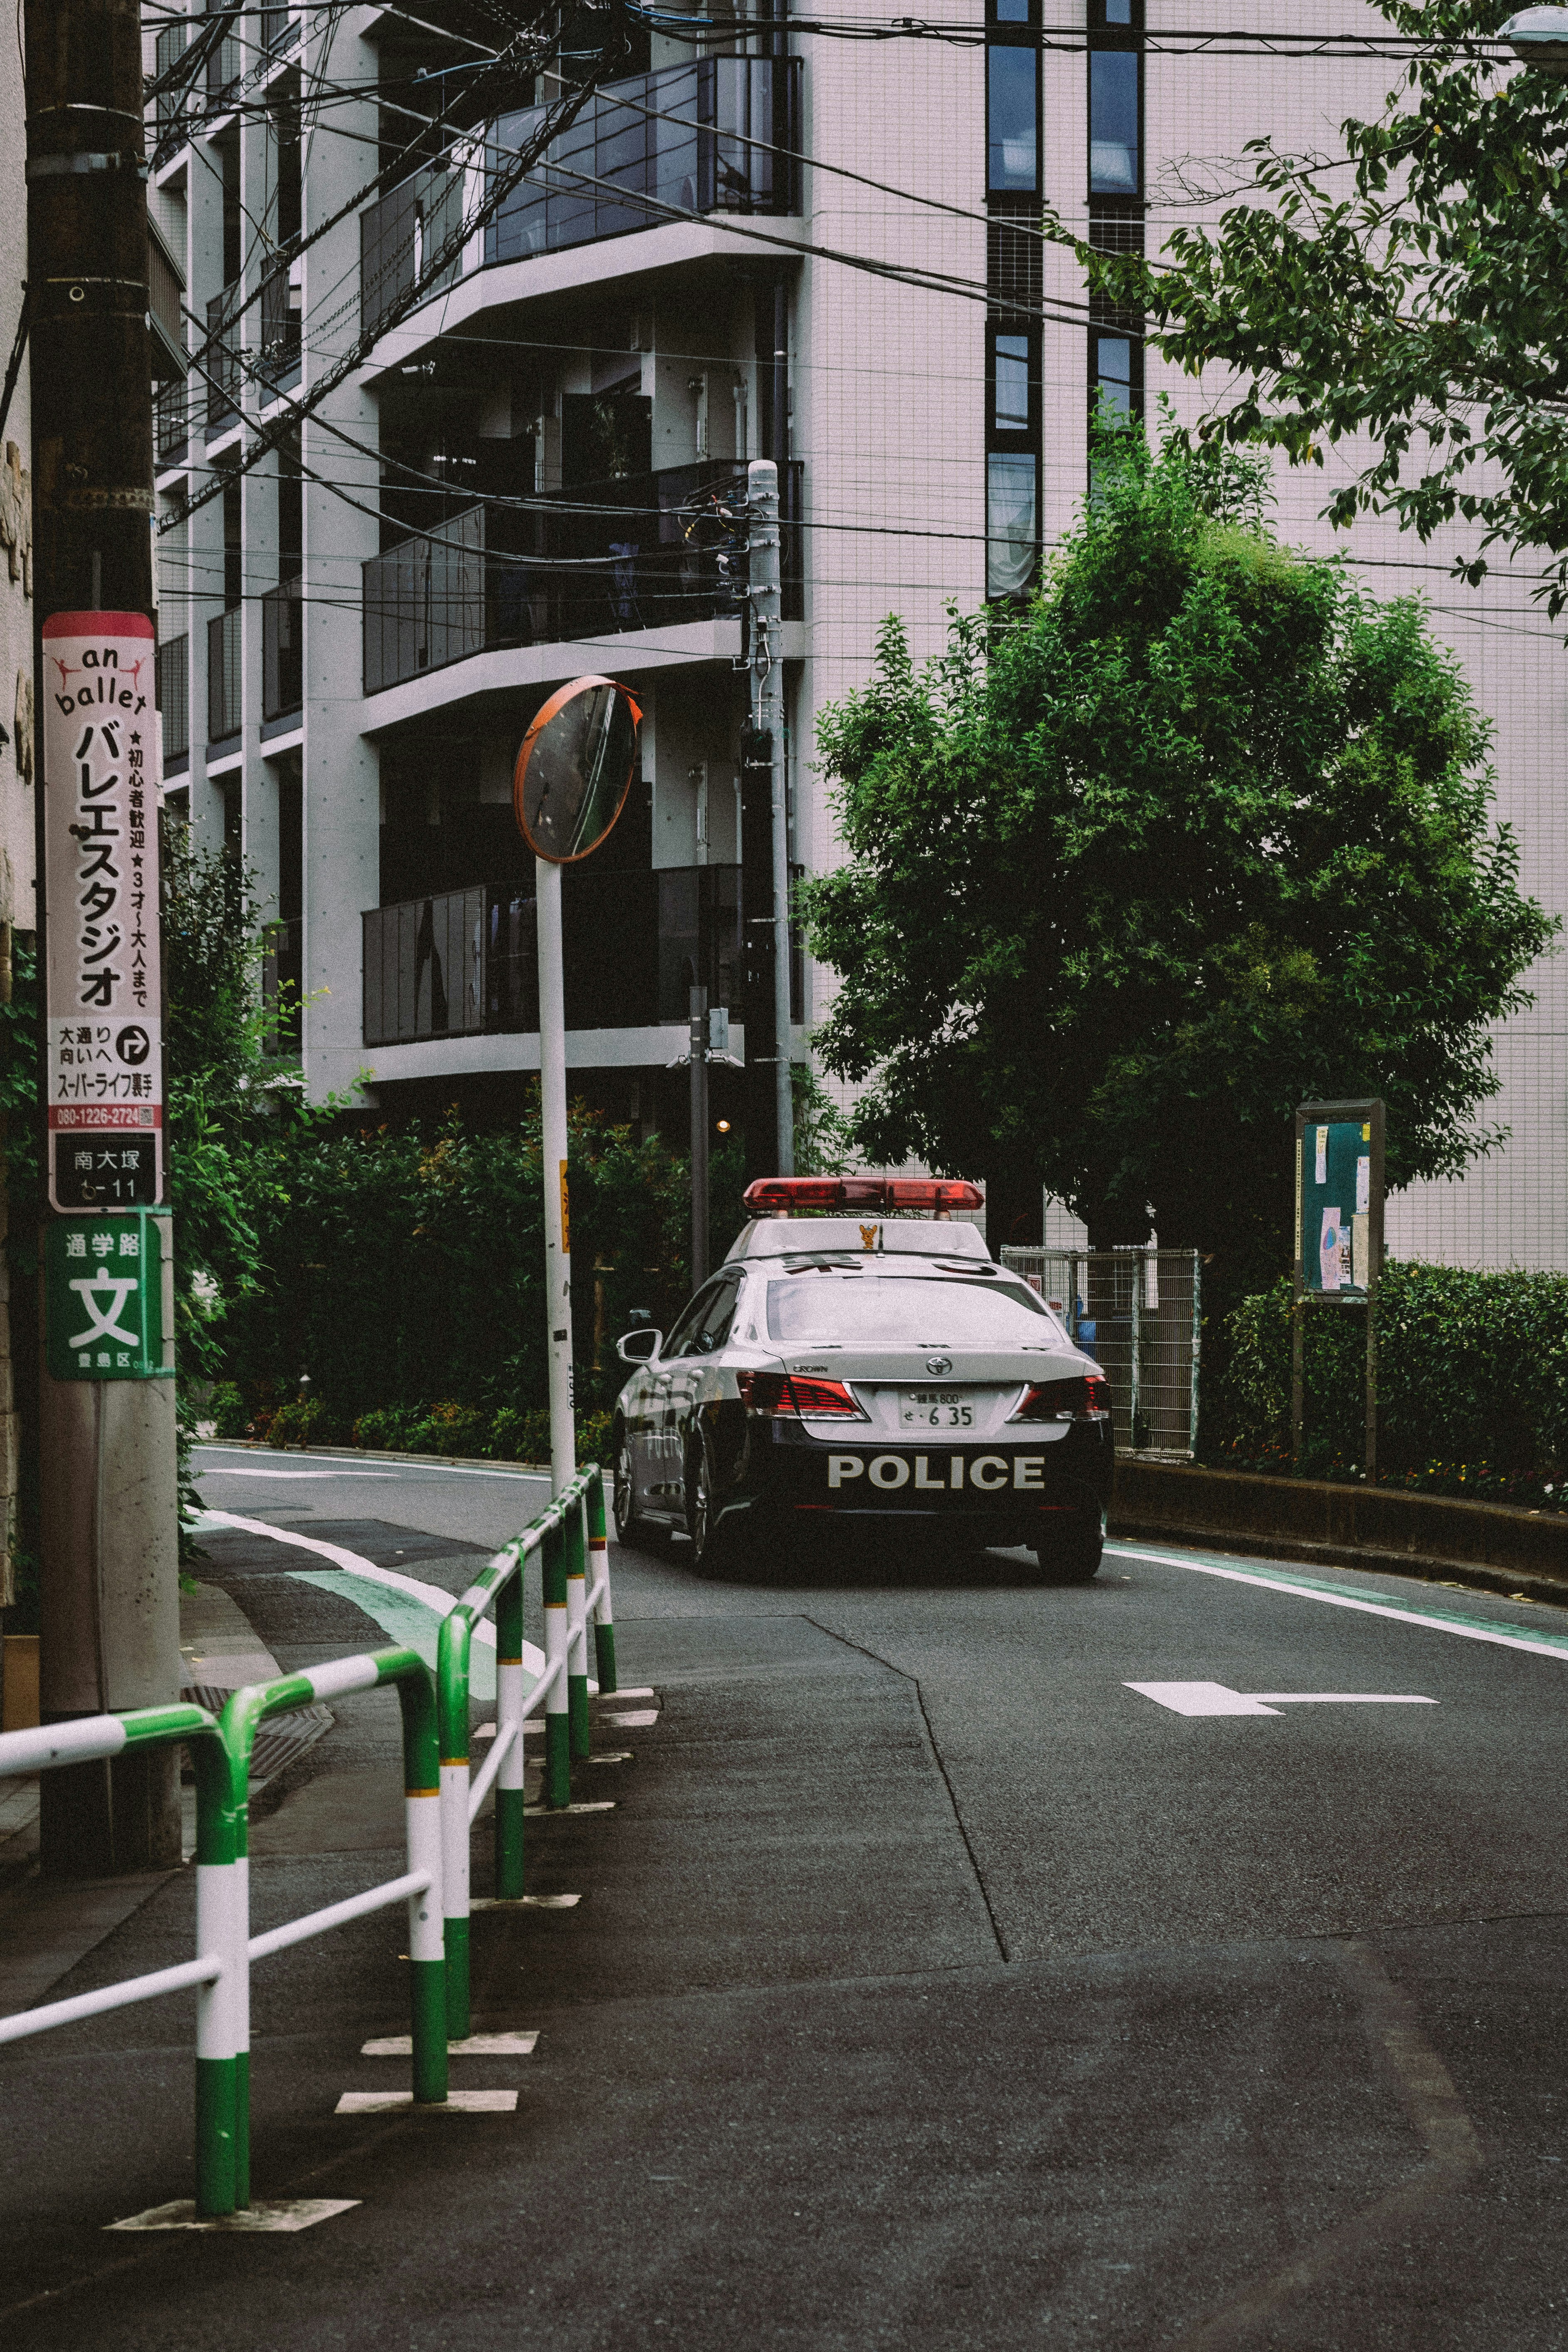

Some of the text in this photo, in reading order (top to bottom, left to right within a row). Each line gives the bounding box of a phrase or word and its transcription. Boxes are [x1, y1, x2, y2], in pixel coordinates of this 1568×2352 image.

[82, 648, 118, 668] an
[55, 676, 146, 716] ballet
[76, 720, 120, 1007] バレエスタジオ
[59, 1027, 111, 1044] 大通り
[60, 1048, 112, 1065] 向いへ
[57, 1107, 139, 1125] 080-1226-2724
[74, 1150, 140, 1170] 南大塚
[66, 1233, 140, 1257] 通学路
[69, 1266, 139, 1348] 文
[78, 1352, 131, 1368] 豊島区
[793, 1364, 829, 1373] CROWN
[940, 1394, 959, 1404] 800
[904, 1411, 914, 1421] せ
[828, 1455, 1045, 1490] POLICE
